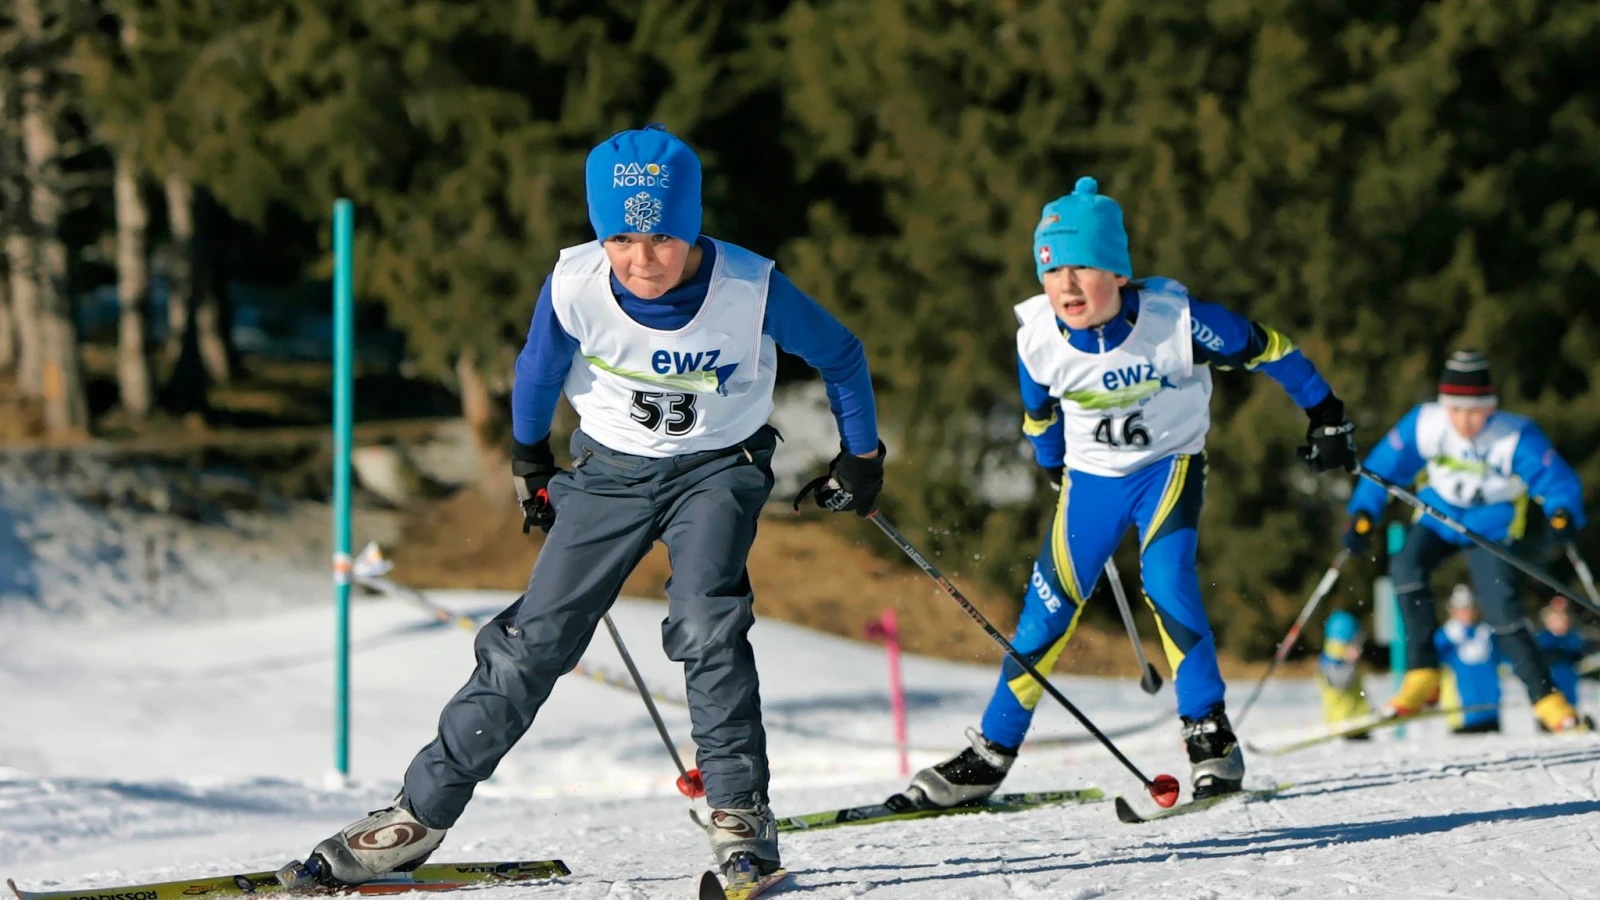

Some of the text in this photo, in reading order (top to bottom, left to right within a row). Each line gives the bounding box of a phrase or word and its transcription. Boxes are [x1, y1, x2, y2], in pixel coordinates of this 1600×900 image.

[613, 162, 669, 177] DAVOS
[613, 175, 670, 188] NORDIC
[652, 349, 721, 374] ewz
[1102, 363, 1159, 391] ewz
[630, 389, 698, 436] 53
[1092, 409, 1152, 450] 46
[1031, 560, 1062, 614] ODE
